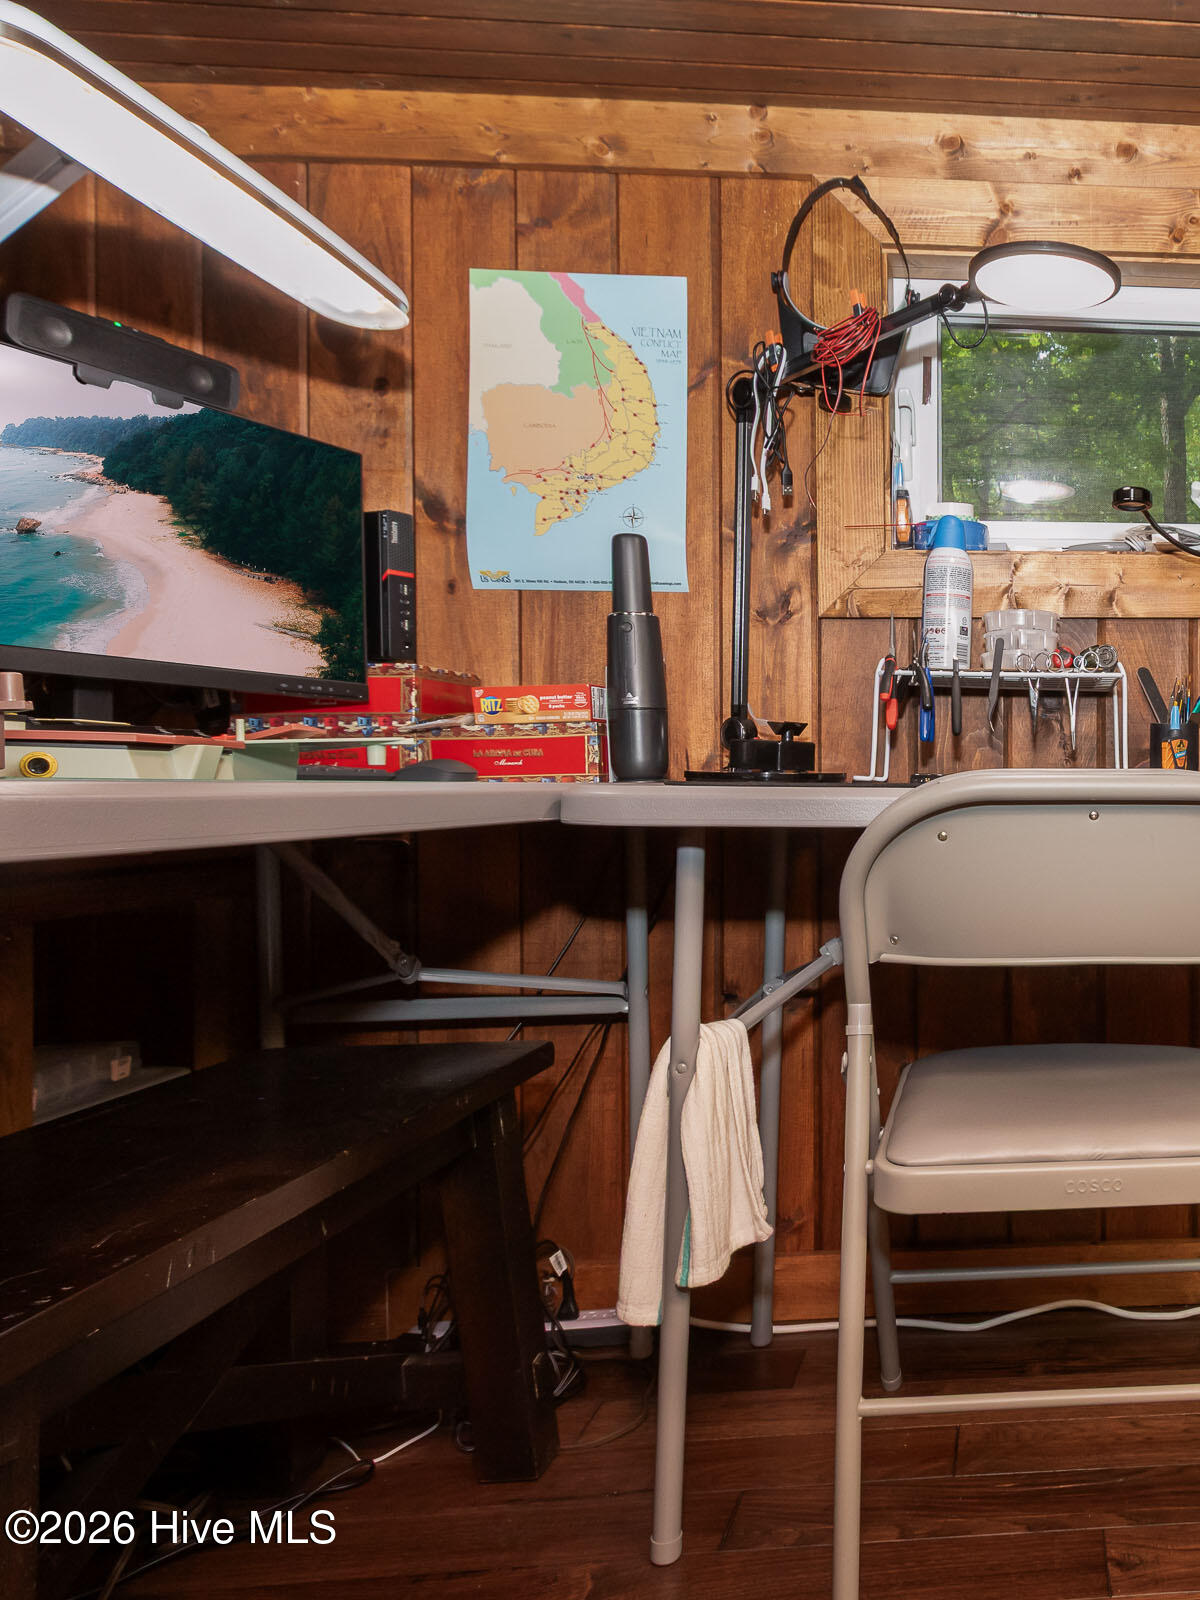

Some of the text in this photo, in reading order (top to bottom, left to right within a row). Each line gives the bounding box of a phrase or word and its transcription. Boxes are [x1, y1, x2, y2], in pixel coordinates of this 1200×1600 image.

[631, 327, 682, 339] VIETNAM
[661, 350, 681, 359] MAP
[480, 697, 504, 713] RITZ
